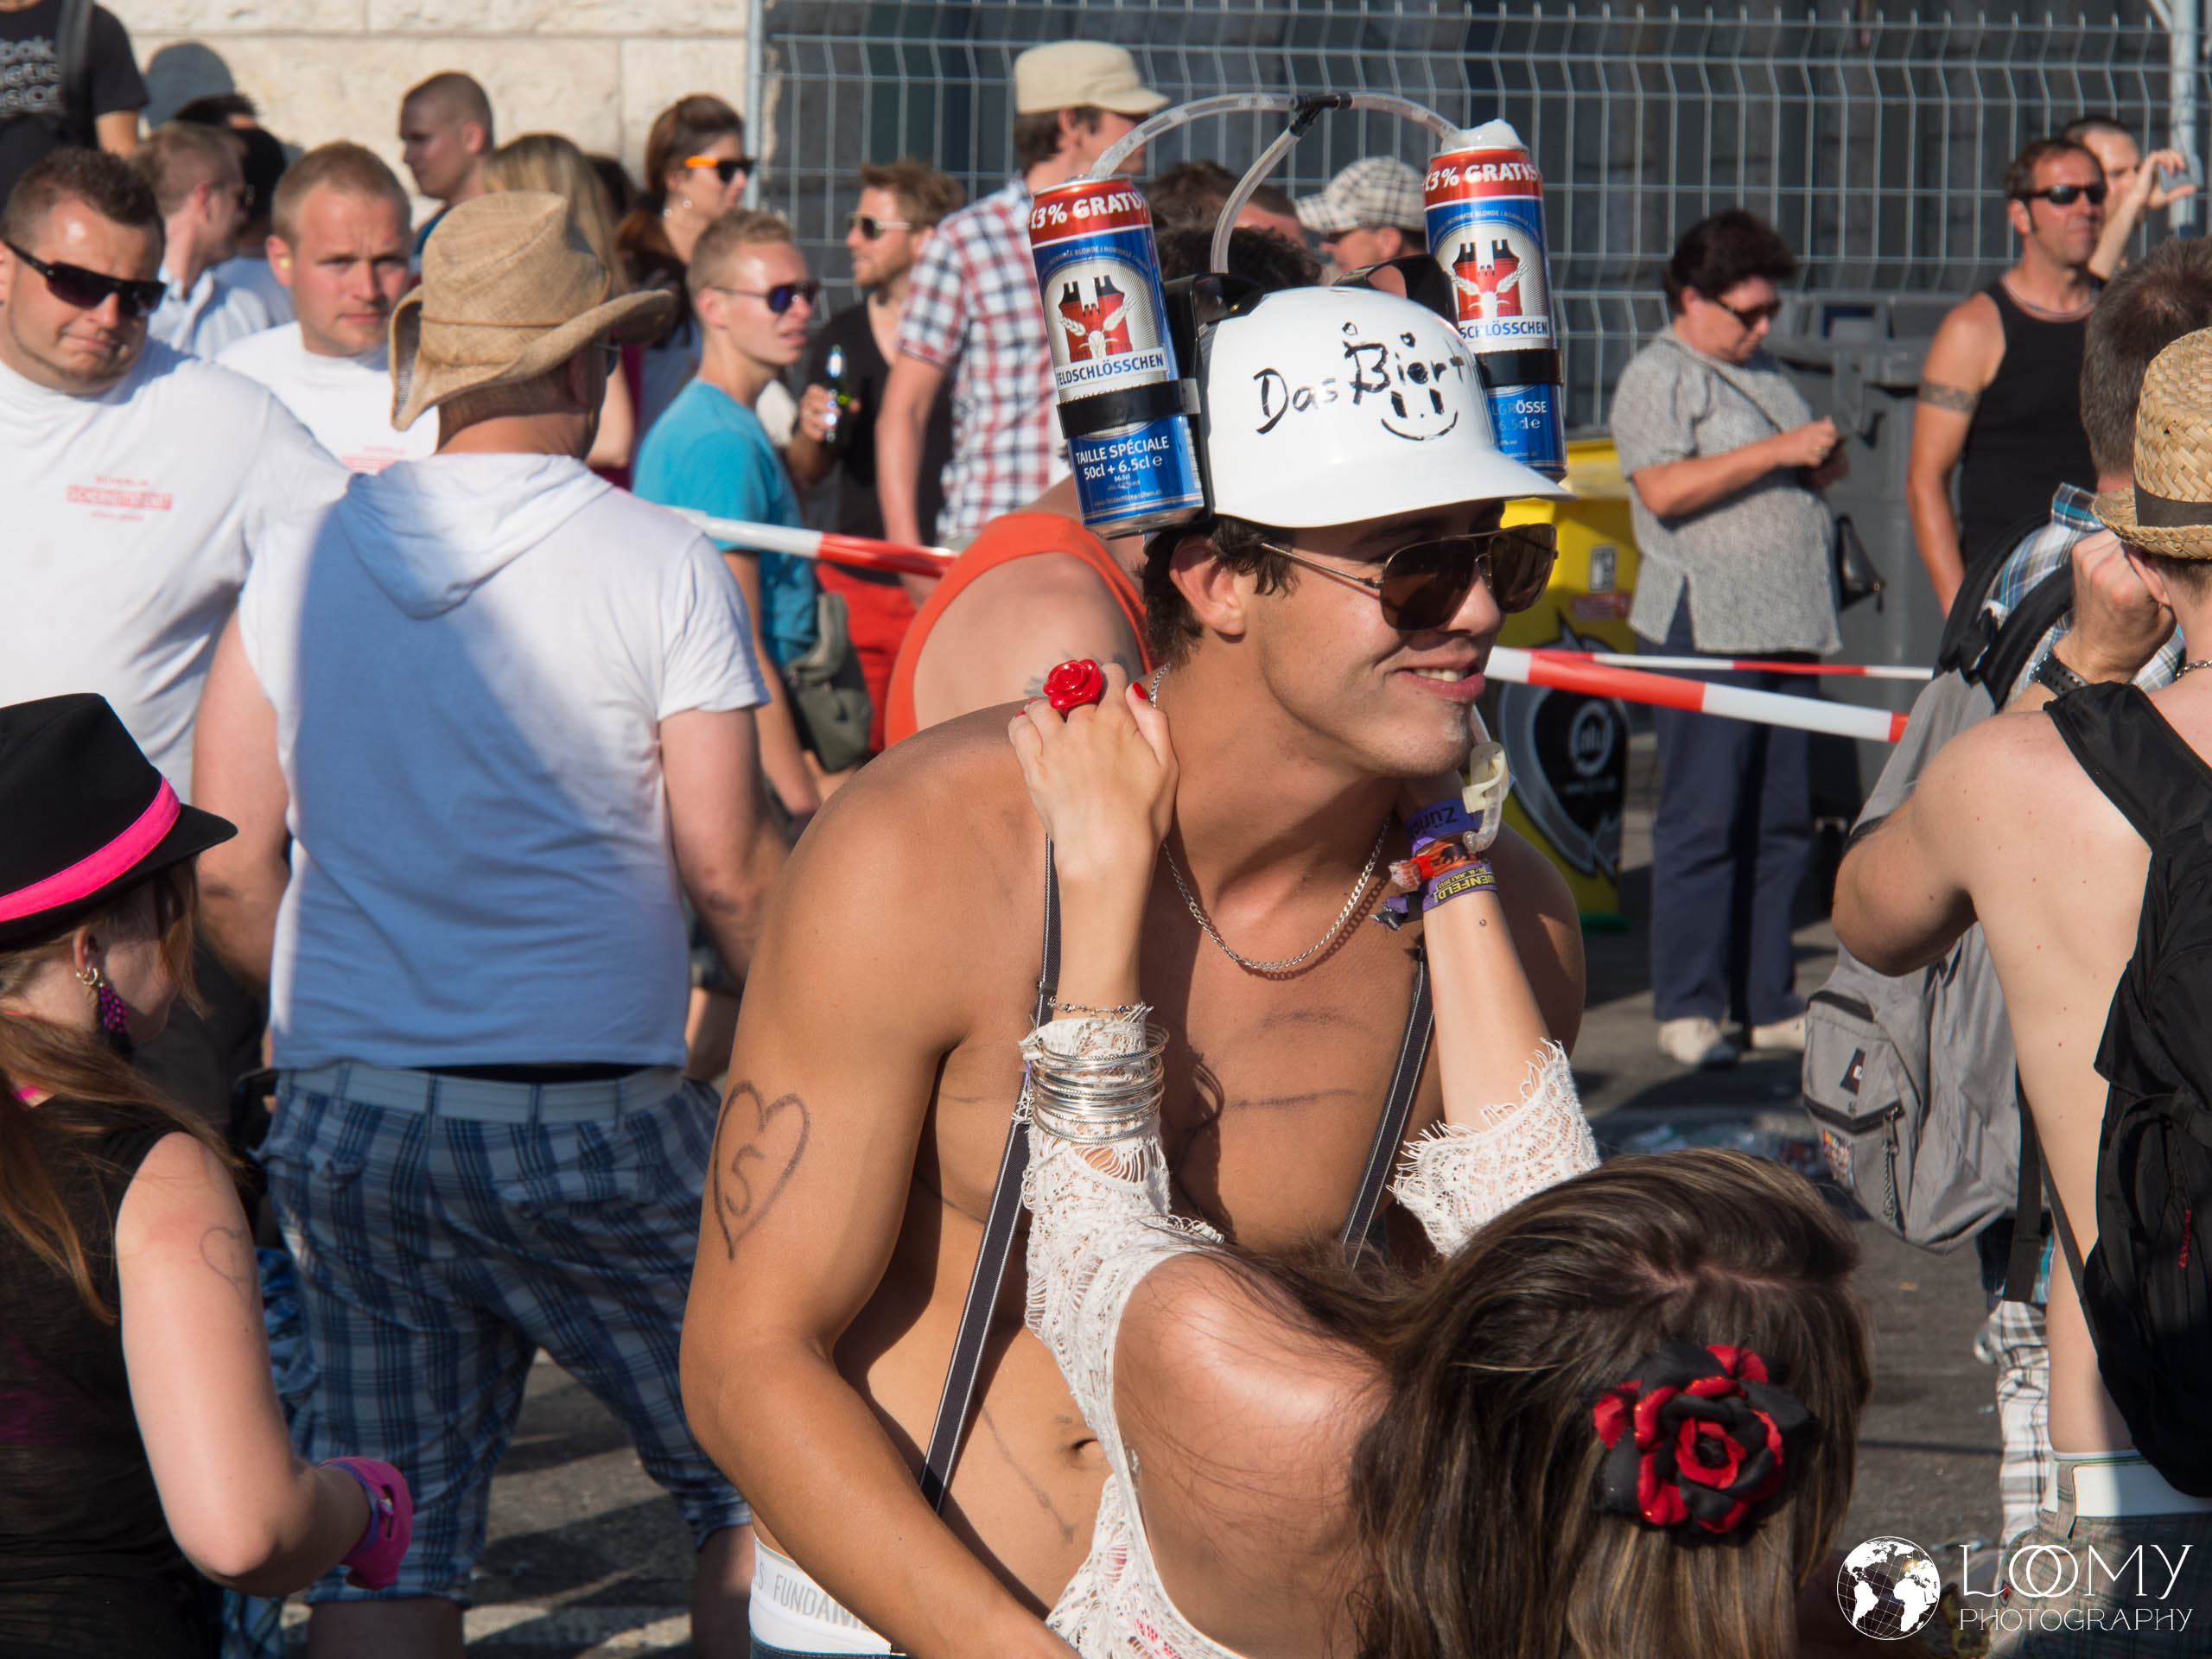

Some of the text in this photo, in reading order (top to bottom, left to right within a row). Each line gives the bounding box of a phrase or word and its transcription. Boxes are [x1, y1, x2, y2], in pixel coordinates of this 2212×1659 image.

[1465, 162, 1539, 184] GRATIS
[1072, 192, 1148, 219] GRATU
[1253, 367, 1339, 435] Das
[1075, 435, 1170, 464] TAILLE SPÉCIALE
[1084, 465, 1106, 481] 50cl
[1117, 456, 1151, 474] 6.5cl
[1437, 874, 1494, 899] UENFELD
[772, 1573, 872, 1632] FUNDAM
